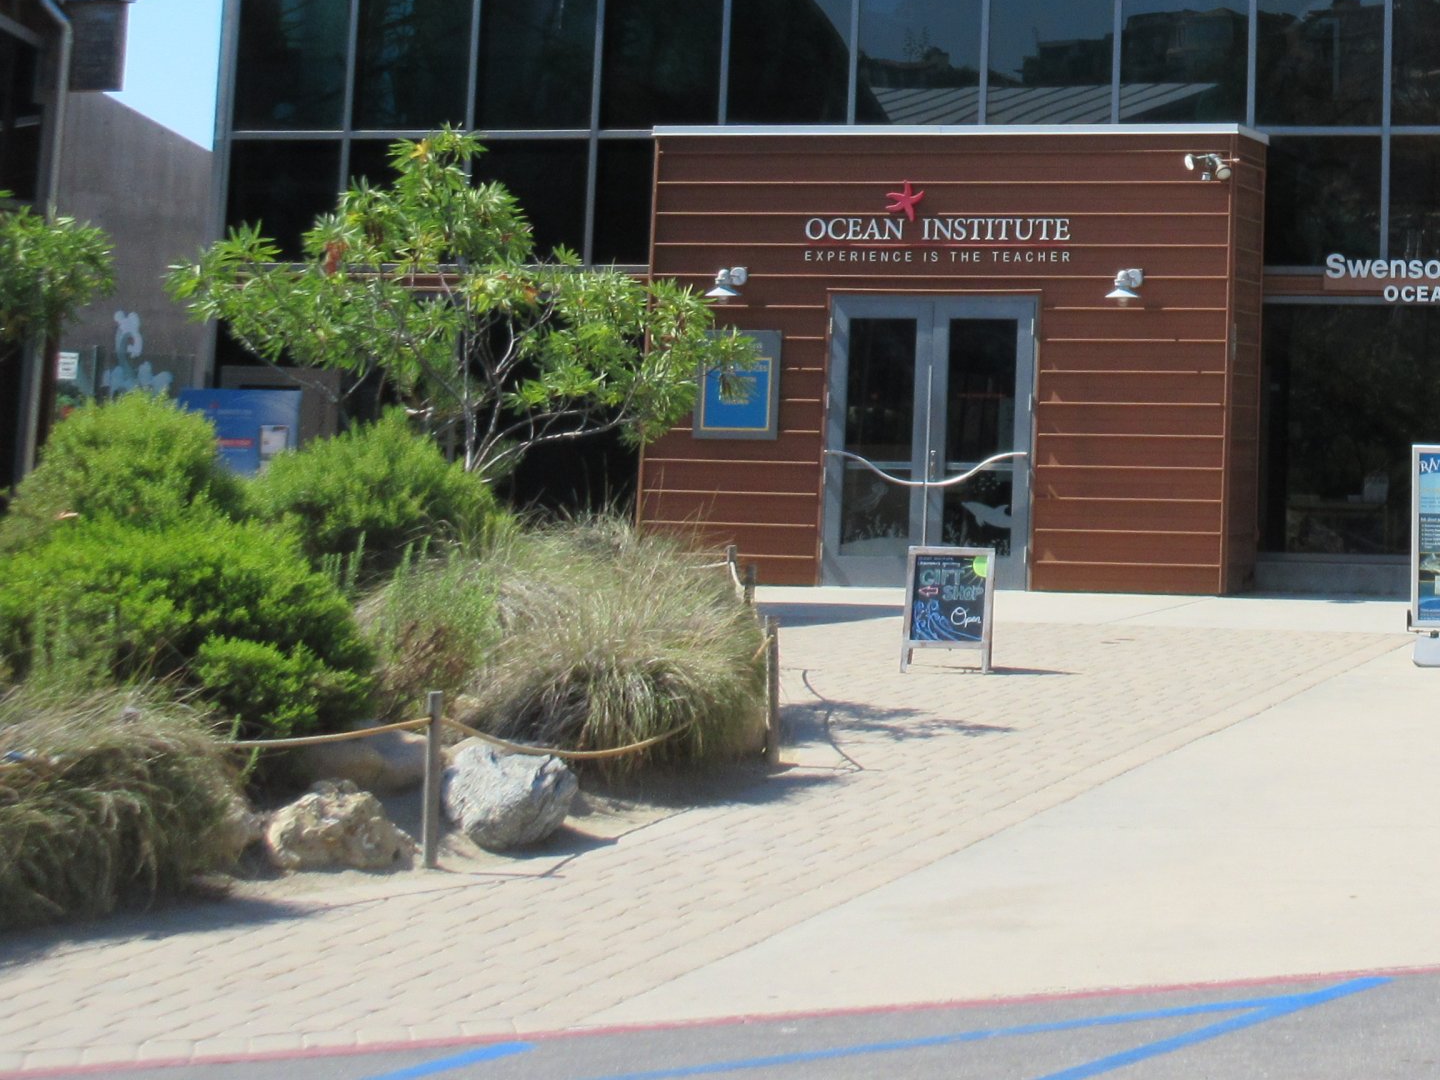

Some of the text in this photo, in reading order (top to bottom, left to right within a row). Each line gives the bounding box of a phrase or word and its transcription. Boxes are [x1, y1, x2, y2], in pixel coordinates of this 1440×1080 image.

[805, 218, 1071, 241] OCEAN INSTITUTE
[804, 250, 1071, 262] EXPERIENCE IS THE TEACHER
[920, 569, 965, 585] GIFT
[942, 585, 984, 601] SHOP
[950, 606, 981, 628] Open
